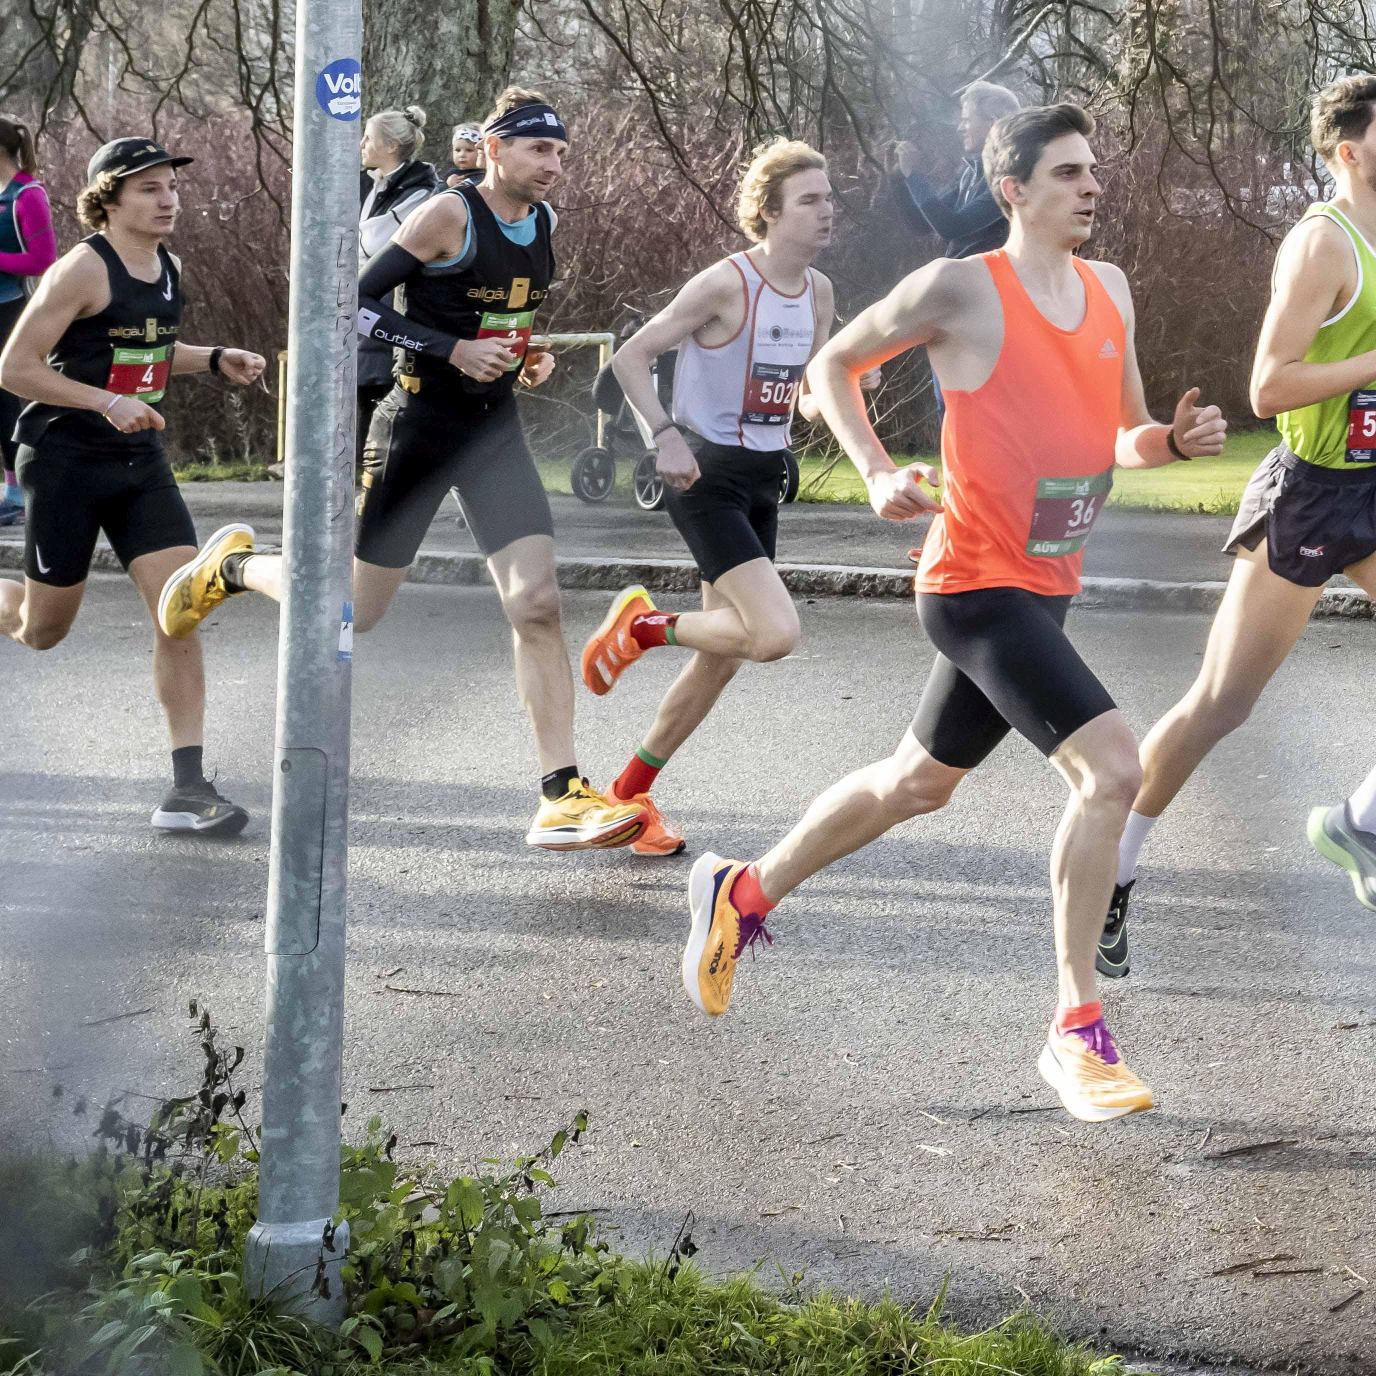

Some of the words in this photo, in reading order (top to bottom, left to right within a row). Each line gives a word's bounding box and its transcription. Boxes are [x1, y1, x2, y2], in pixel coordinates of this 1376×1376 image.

[374, 328, 424, 351] outlet
[141, 364, 154, 384] 4
[1067, 497, 1096, 528] 36
